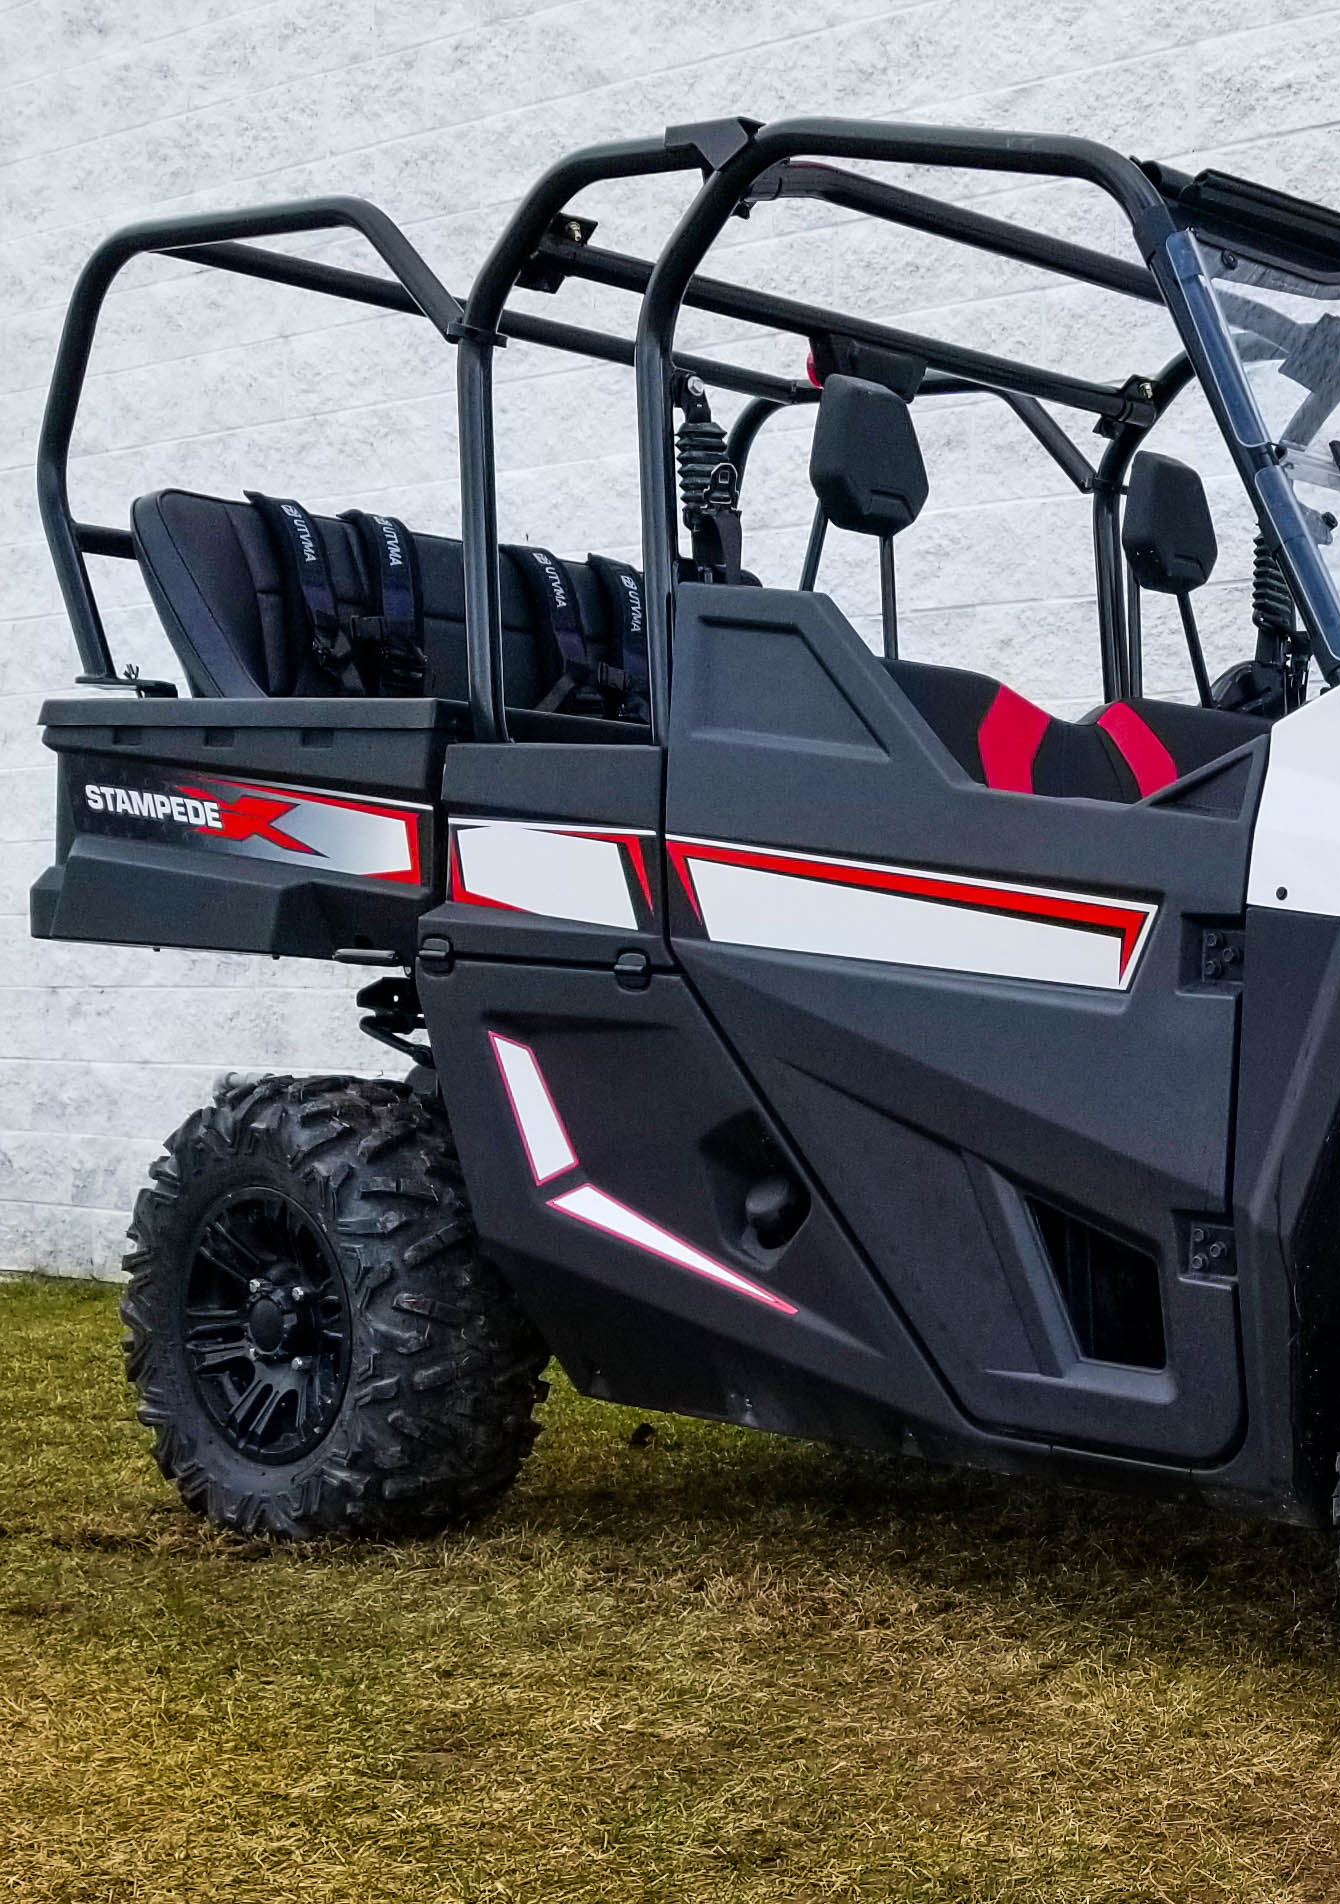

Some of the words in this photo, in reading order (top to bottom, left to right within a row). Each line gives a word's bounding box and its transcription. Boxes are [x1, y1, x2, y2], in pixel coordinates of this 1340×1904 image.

[293, 519, 317, 562] UTVMA
[382, 525, 403, 567] UTVMA
[545, 567, 567, 608] UTVMA
[628, 591, 643, 632] UTVMA
[84, 784, 223, 829] STAMPEDE
